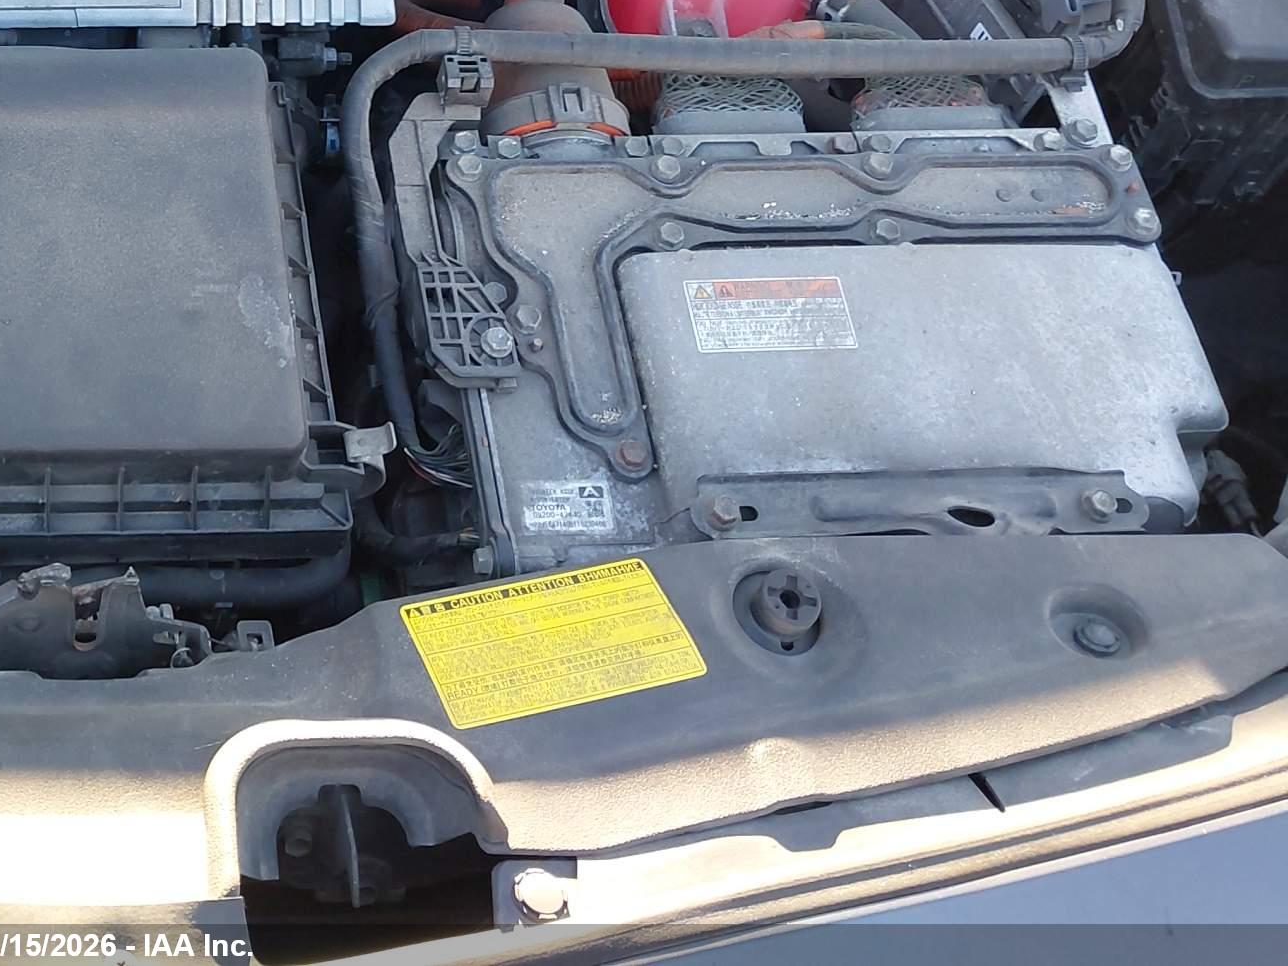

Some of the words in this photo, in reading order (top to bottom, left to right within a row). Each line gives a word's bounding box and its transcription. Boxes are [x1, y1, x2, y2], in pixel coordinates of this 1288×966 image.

[582, 487, 601, 497] A
[451, 591, 503, 610] CAUTION
[508, 576, 574, 597] ATTENTION
[577, 562, 643, 583] ВНИМАНИЕ
[447, 686, 478, 700] READY
